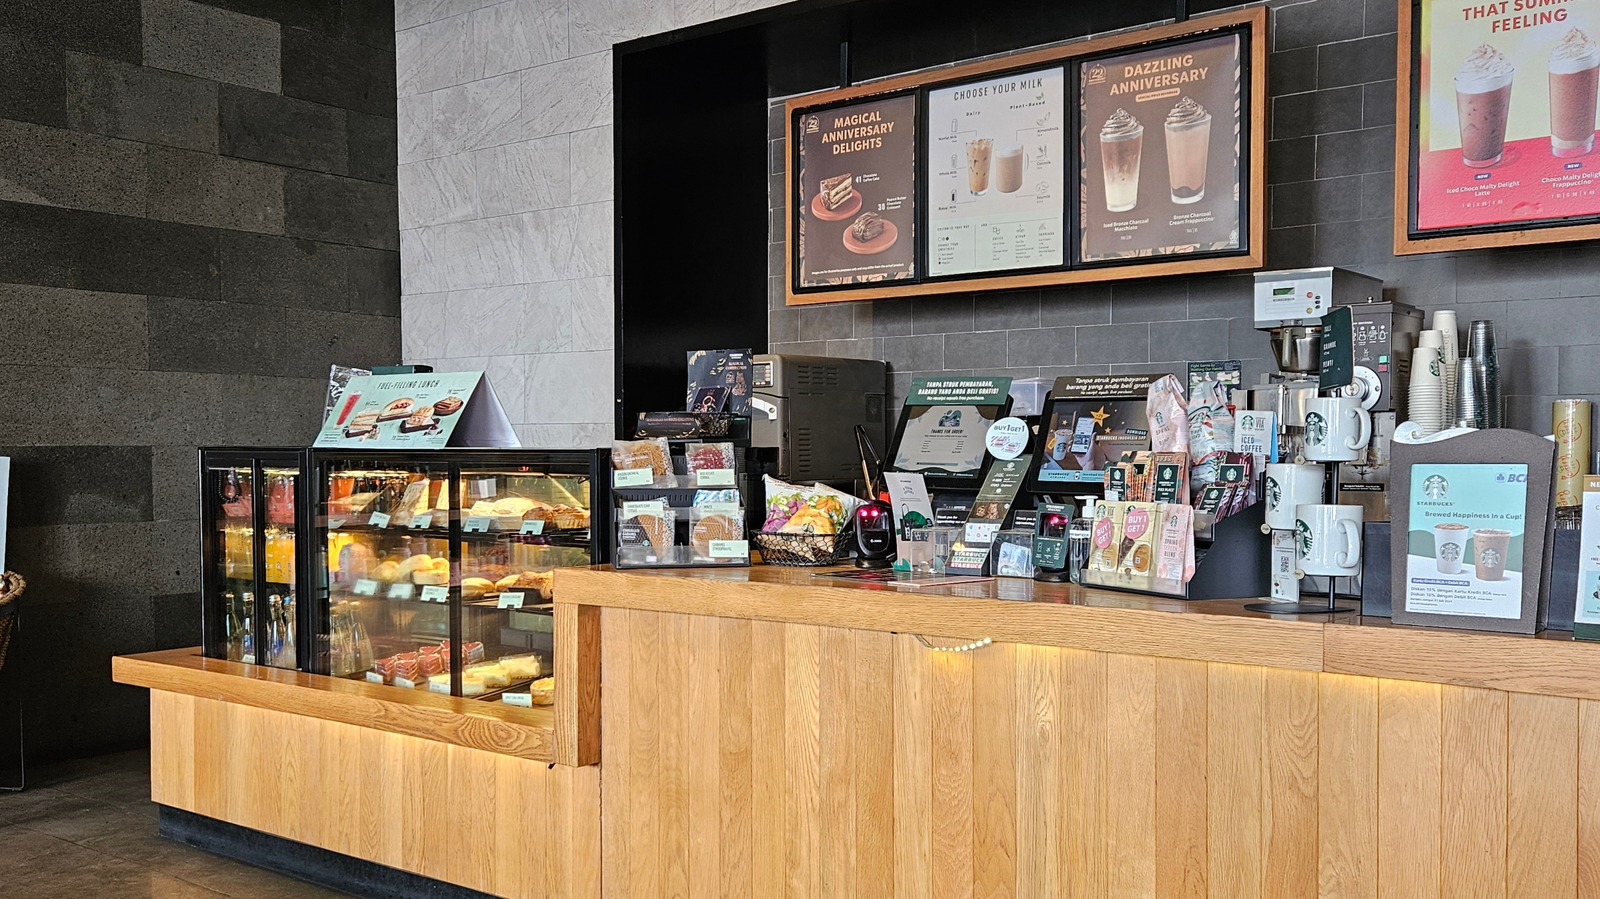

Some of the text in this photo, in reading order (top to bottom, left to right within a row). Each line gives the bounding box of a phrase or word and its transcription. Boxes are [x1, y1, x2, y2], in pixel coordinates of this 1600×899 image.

[1462, 1, 1510, 20] THAT
[1492, 8, 1568, 33] FEELING
[1124, 54, 1193, 78] DAZZLING
[954, 78, 1043, 101] CHOOSE YOUR MILK
[1110, 67, 1208, 96] ANNIVERSARY
[1010, 101, 1046, 110] Plant-Based
[834, 111, 882, 128] MAGICAL
[822, 122, 895, 144] ANNIVERSARY
[833, 138, 882, 155] DELIGHTS
[1552, 179, 1592, 188] Frappuccino
[377, 380, 440, 390] FUEL-FILLING LUNCH
[1241, 444, 1262, 452] COFFEE
[1096, 527, 1108, 536] BUY
[1098, 534, 1108, 544] GET
